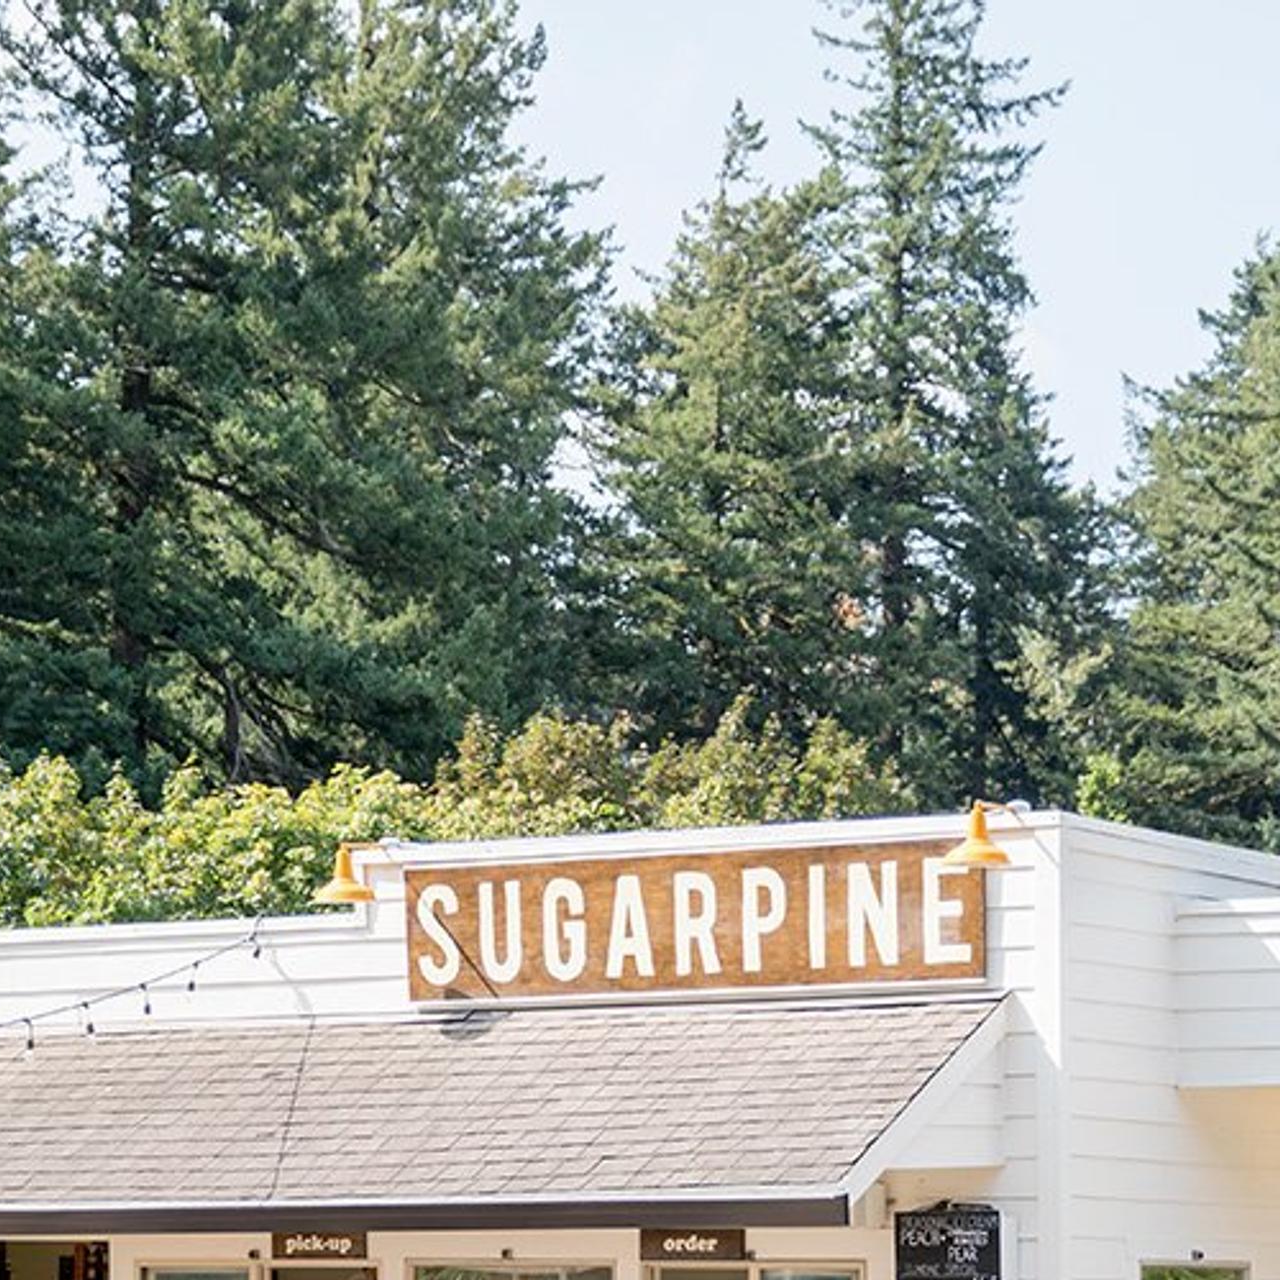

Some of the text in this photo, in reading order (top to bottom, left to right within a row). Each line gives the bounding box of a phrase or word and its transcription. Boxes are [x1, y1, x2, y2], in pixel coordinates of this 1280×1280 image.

[416, 858, 973, 987] SUGARPINE
[285, 1234, 352, 1254] pick-up
[662, 1234, 718, 1251] order
